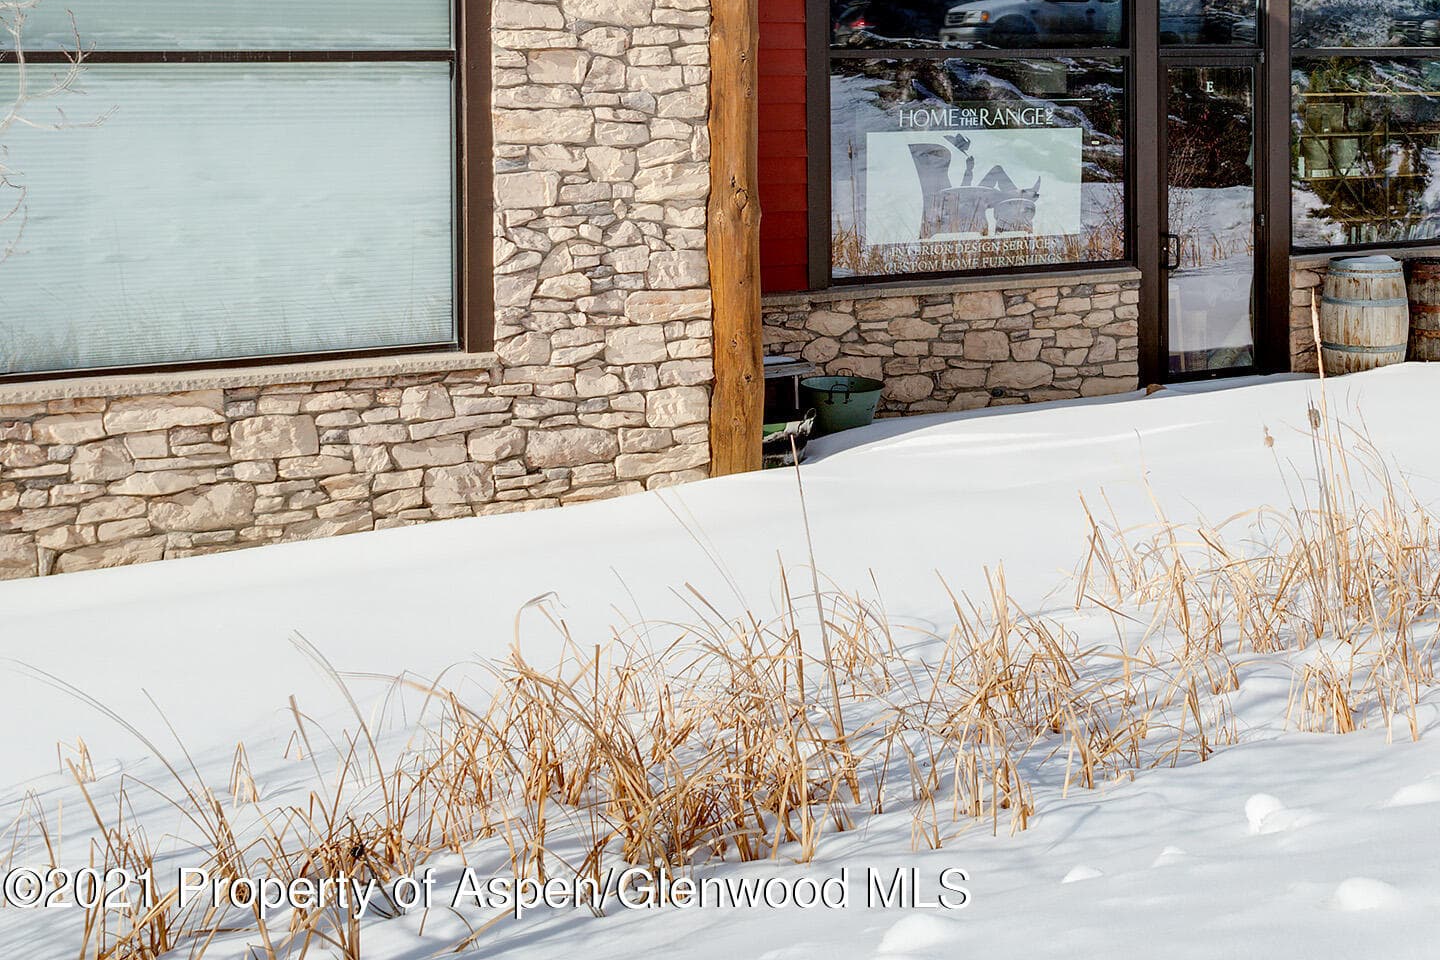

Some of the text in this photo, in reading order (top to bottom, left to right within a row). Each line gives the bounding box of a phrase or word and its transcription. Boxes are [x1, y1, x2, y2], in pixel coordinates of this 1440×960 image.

[1206, 81, 1214, 92] E
[899, 108, 1044, 127] HOME ON THE RANGE
[891, 238, 1057, 257] INTERIOR DESIGN SERVICES
[885, 253, 1062, 273] CUSTOM HOME FURNISHINGS
